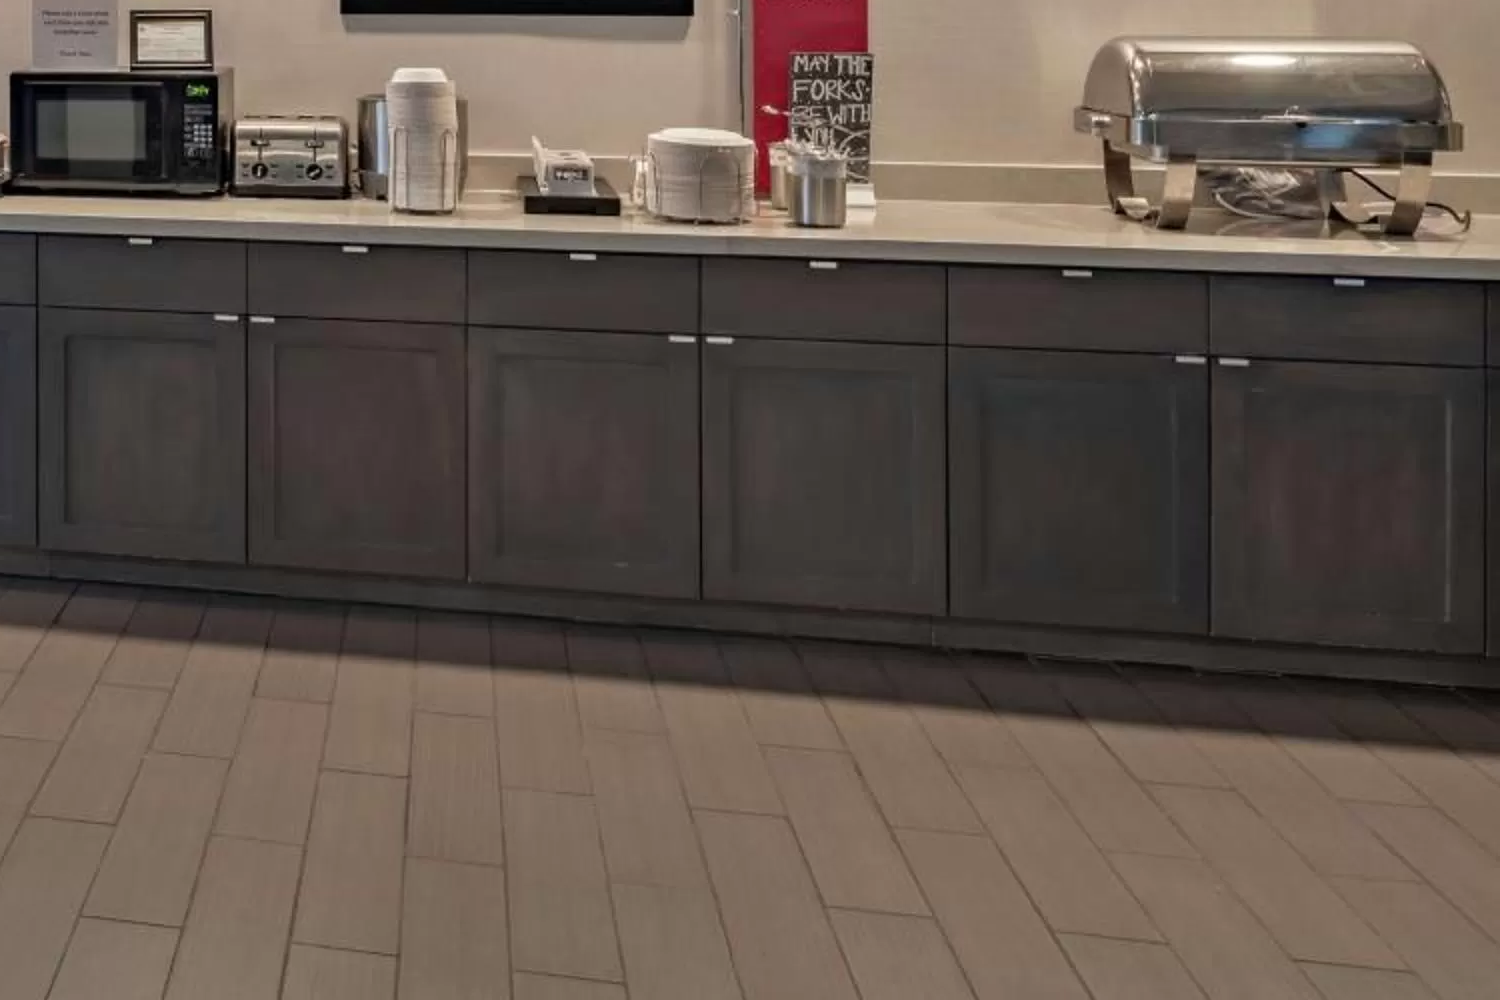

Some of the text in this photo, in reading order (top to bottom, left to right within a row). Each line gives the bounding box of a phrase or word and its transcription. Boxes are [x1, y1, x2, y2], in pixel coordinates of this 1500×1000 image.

[793, 54, 872, 76] MAY THE
[826, 103, 871, 125] WITH
